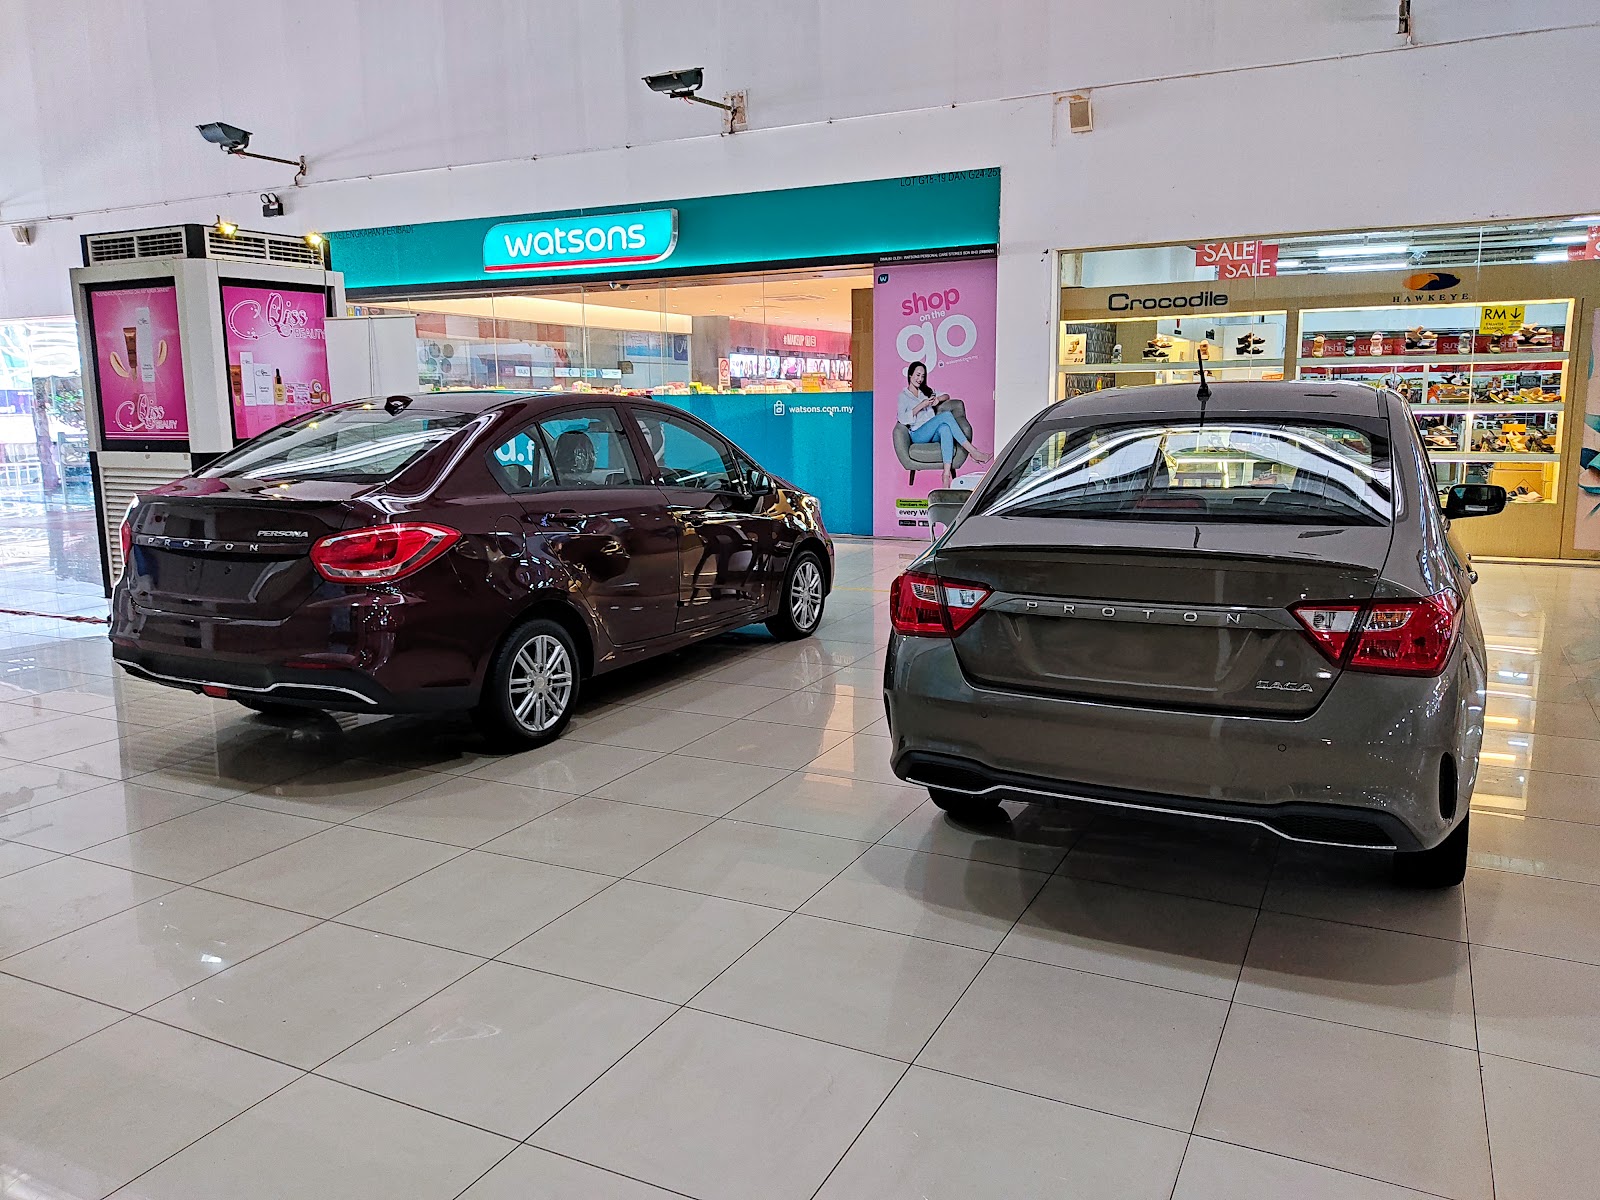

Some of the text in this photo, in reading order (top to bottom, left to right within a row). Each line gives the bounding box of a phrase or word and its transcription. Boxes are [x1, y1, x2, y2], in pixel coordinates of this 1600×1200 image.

[900, 176, 915, 187] LOT
[948, 171, 966, 182] DAN
[382, 224, 414, 236] PERIBADI
[504, 224, 646, 258] watsons
[1225, 259, 1271, 278] SALE
[901, 288, 960, 316] shop
[1108, 291, 1229, 311] Crocodile
[1392, 292, 1469, 303] HAWKEYE
[919, 310, 946, 322] on the
[1484, 308, 1507, 320] RM
[896, 314, 978, 377] go
[788, 405, 854, 414] watsons.com.my
[257, 530, 309, 538] PERSONA
[147, 537, 259, 551] PROTON
[1026, 601, 1242, 625] PROTON
